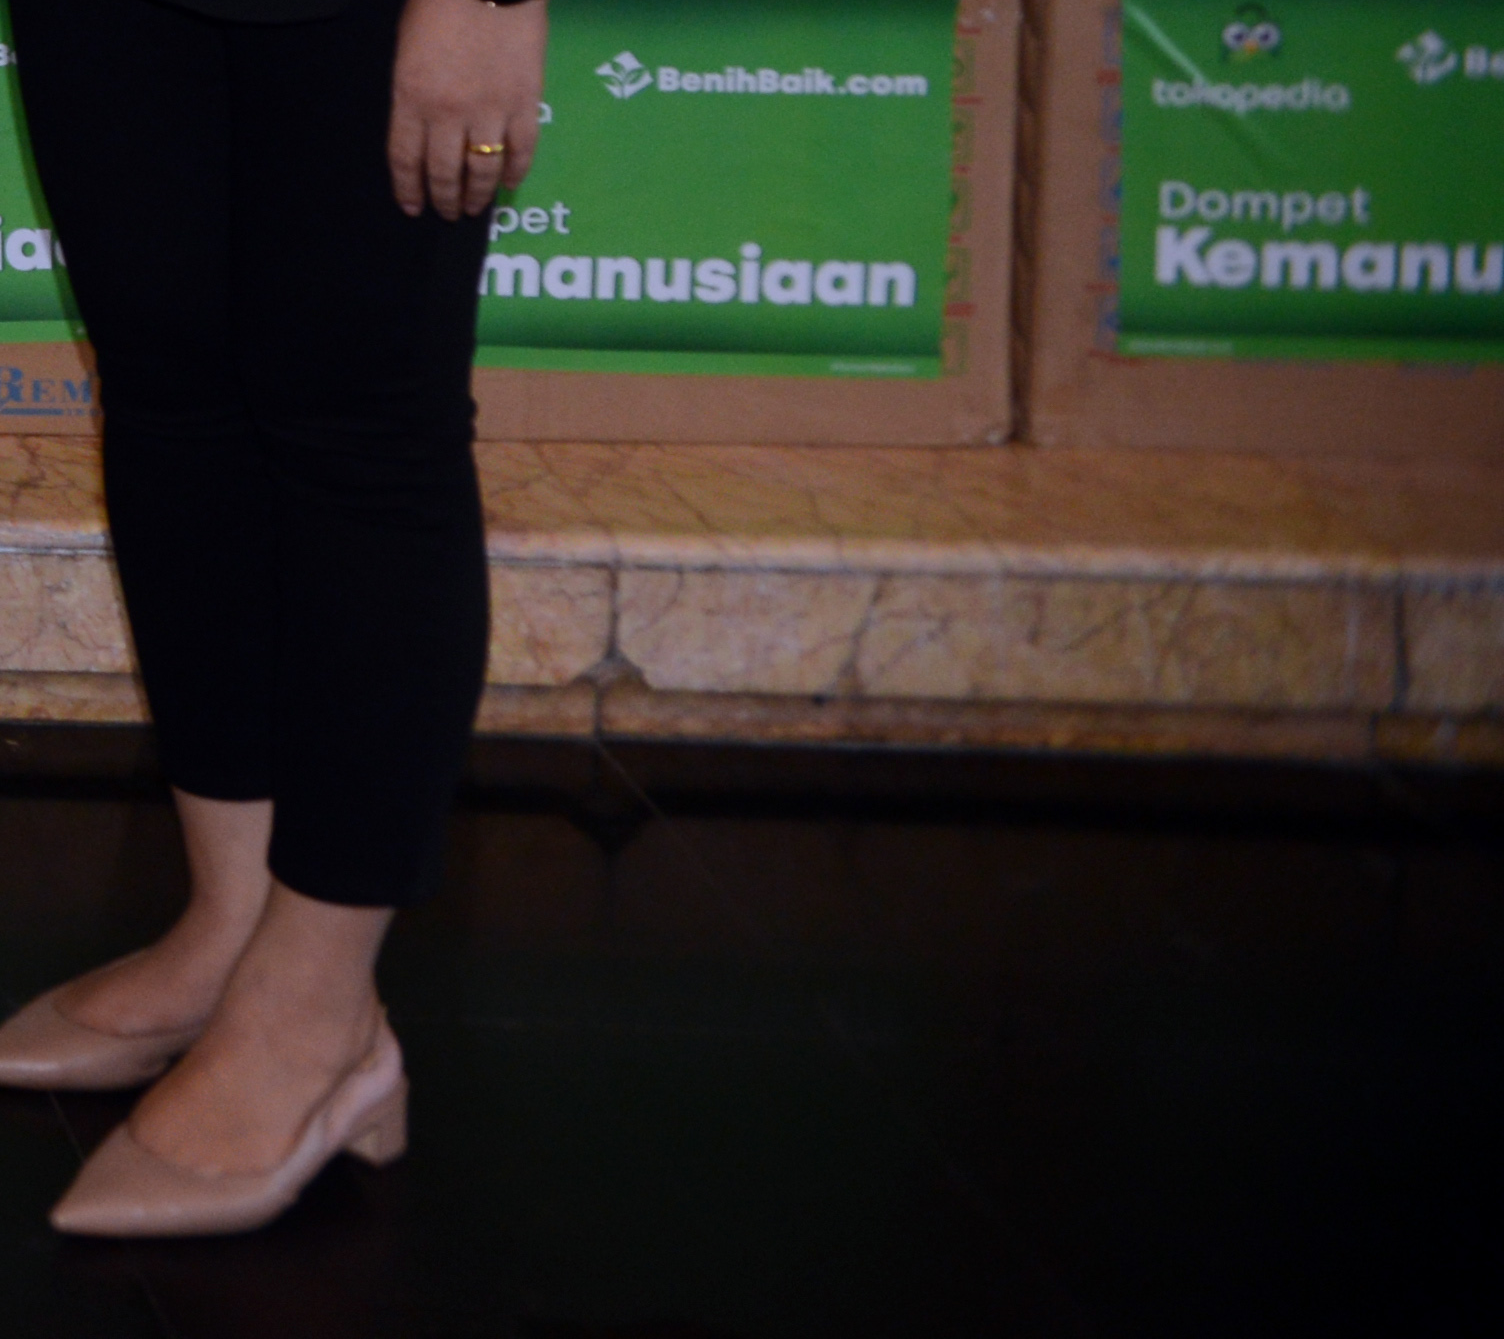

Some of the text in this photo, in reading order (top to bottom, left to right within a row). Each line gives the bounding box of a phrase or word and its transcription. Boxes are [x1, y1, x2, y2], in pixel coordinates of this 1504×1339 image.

[657, 67, 927, 95] BenihBaik.com
[1152, 78, 1352, 117] tokopedia
[1159, 180, 1369, 230] Dompet
